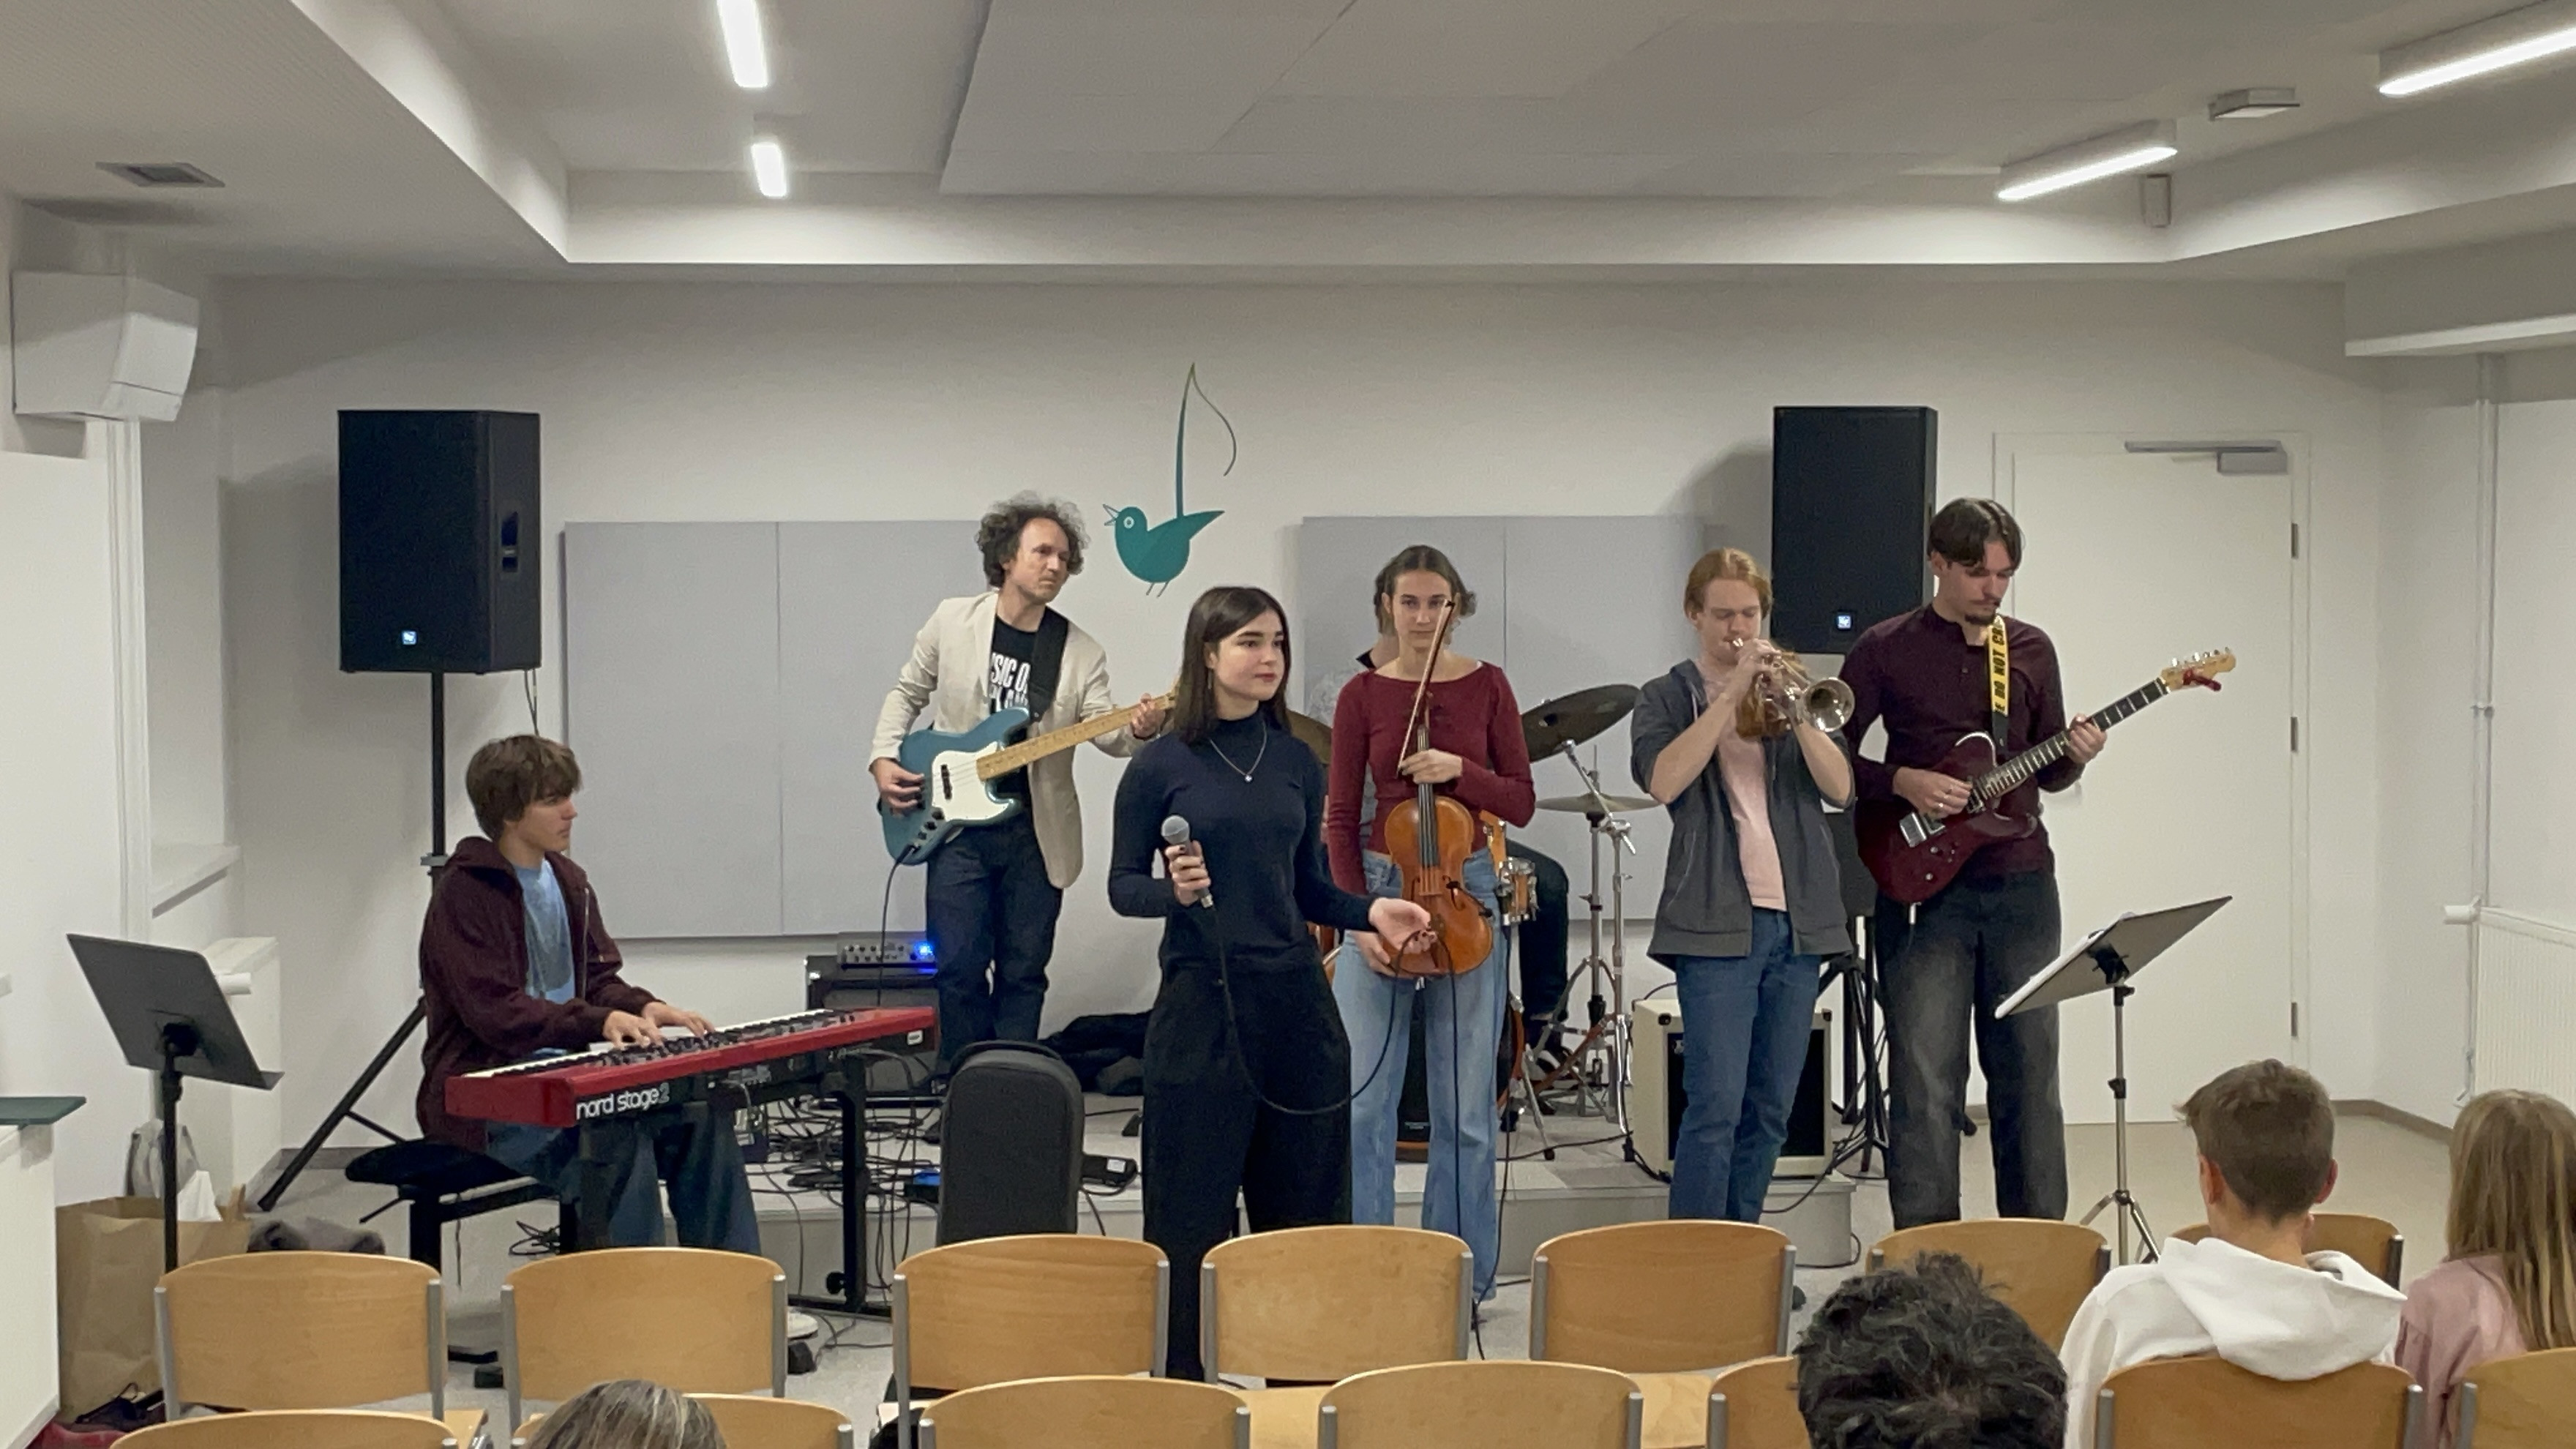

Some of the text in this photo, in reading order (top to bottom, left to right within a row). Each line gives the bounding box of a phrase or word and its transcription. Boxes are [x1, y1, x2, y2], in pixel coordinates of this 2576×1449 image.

[1992, 649, 2005, 676] NOT
[1993, 681, 2005, 700] DO
[576, 1082, 670, 1120] nord stage 2
